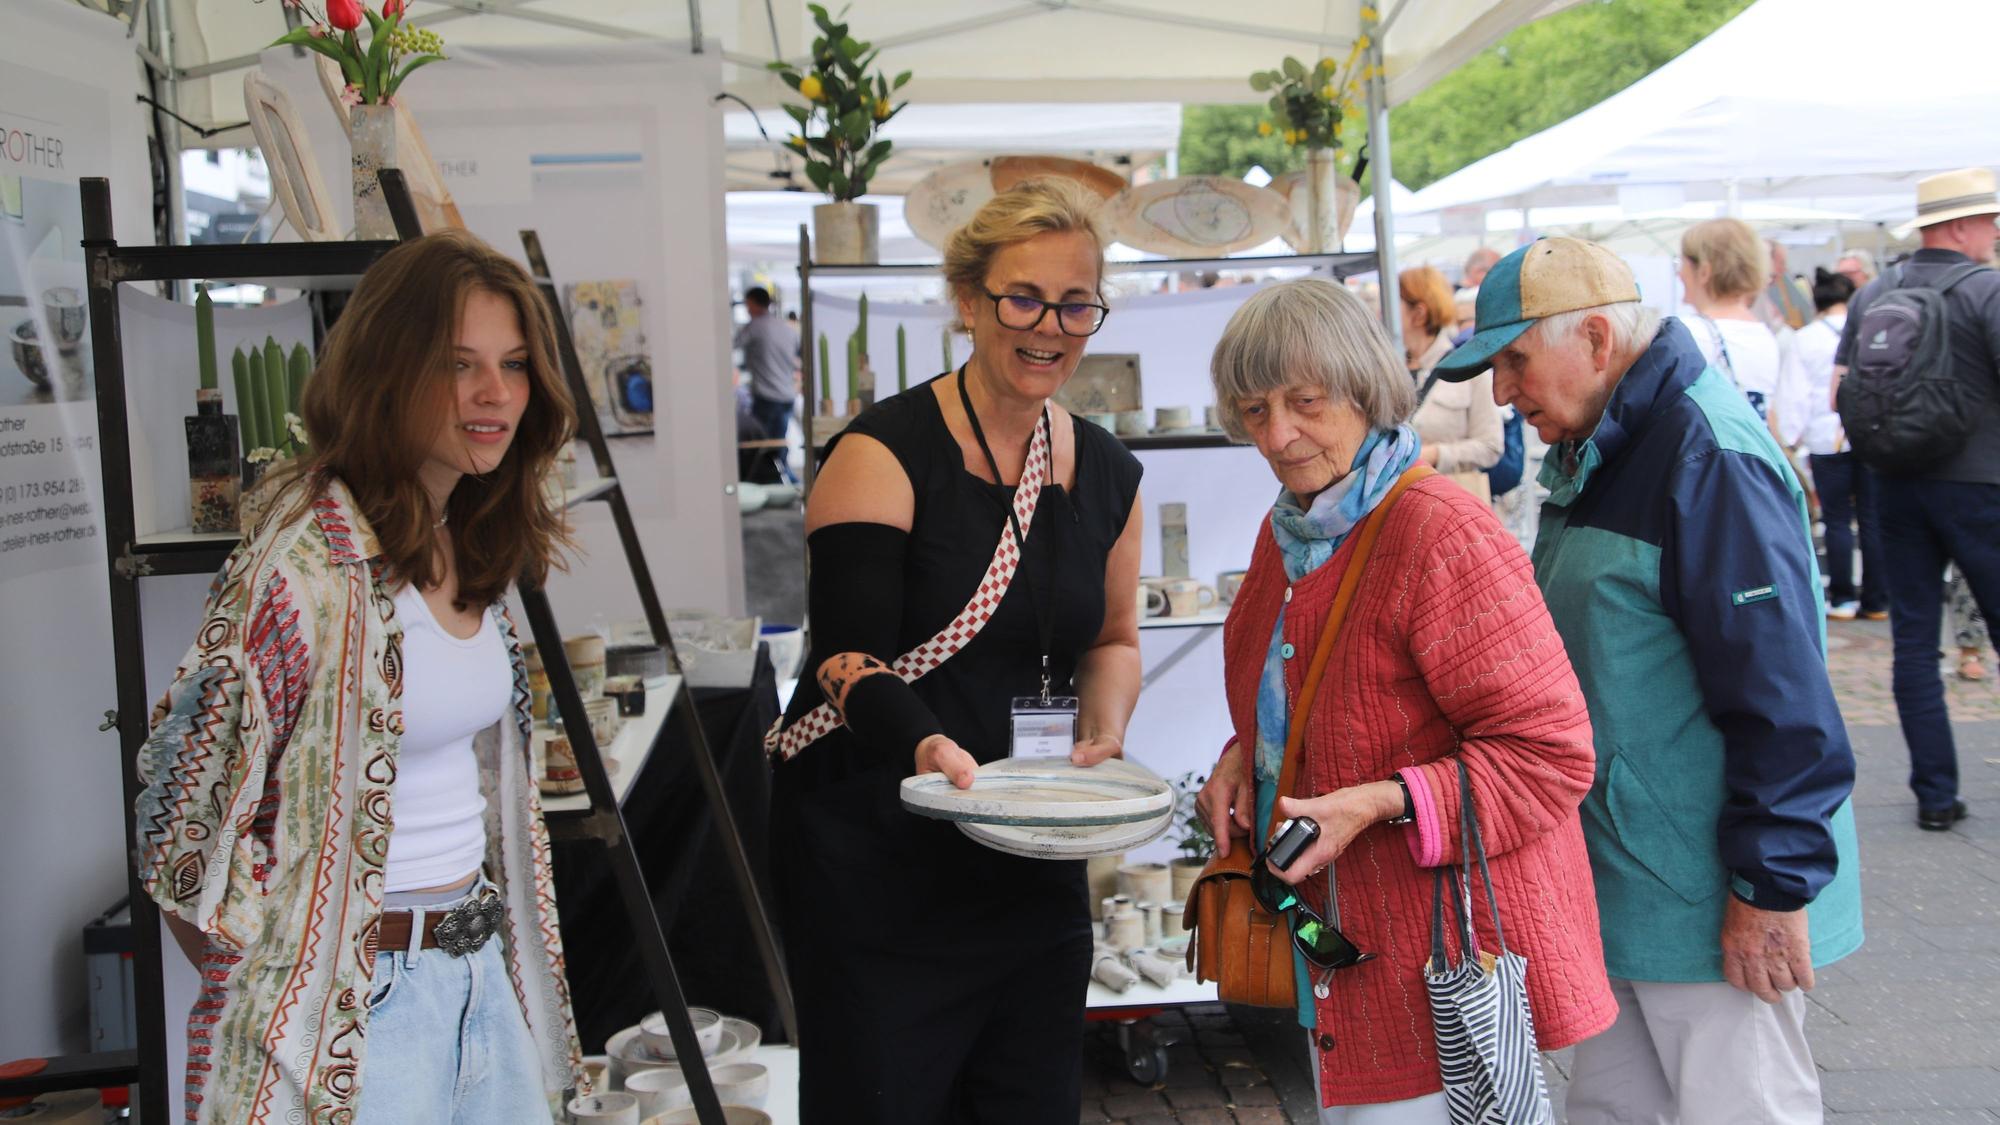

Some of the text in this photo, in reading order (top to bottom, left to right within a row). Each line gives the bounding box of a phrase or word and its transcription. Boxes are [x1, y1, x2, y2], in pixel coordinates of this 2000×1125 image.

[0, 128, 64, 170] ROTHER
[50, 436, 64, 453] 15
[20, 480, 65, 499] 173.954
